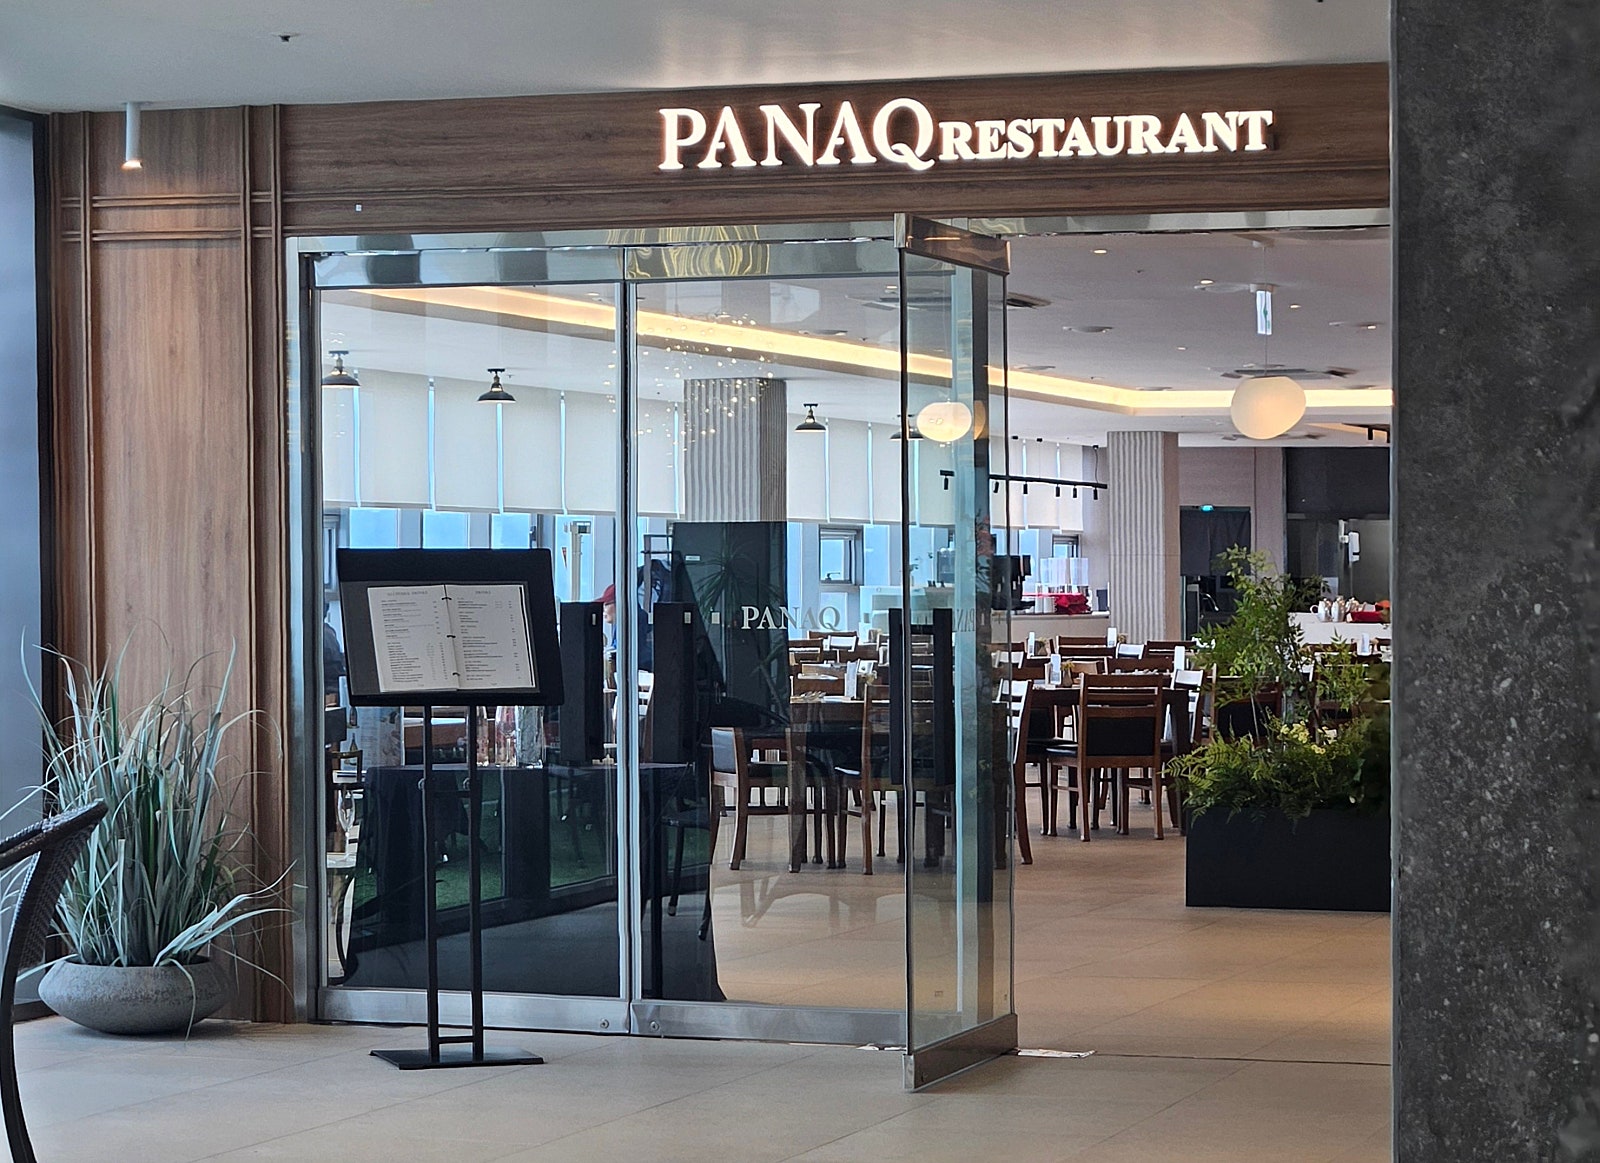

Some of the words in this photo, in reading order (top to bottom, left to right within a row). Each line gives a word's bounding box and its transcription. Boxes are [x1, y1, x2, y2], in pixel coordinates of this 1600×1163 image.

[658, 98, 935, 171] PANAQ
[938, 110, 1273, 161] RESTAURANT
[741, 605, 842, 632] PANAQ
